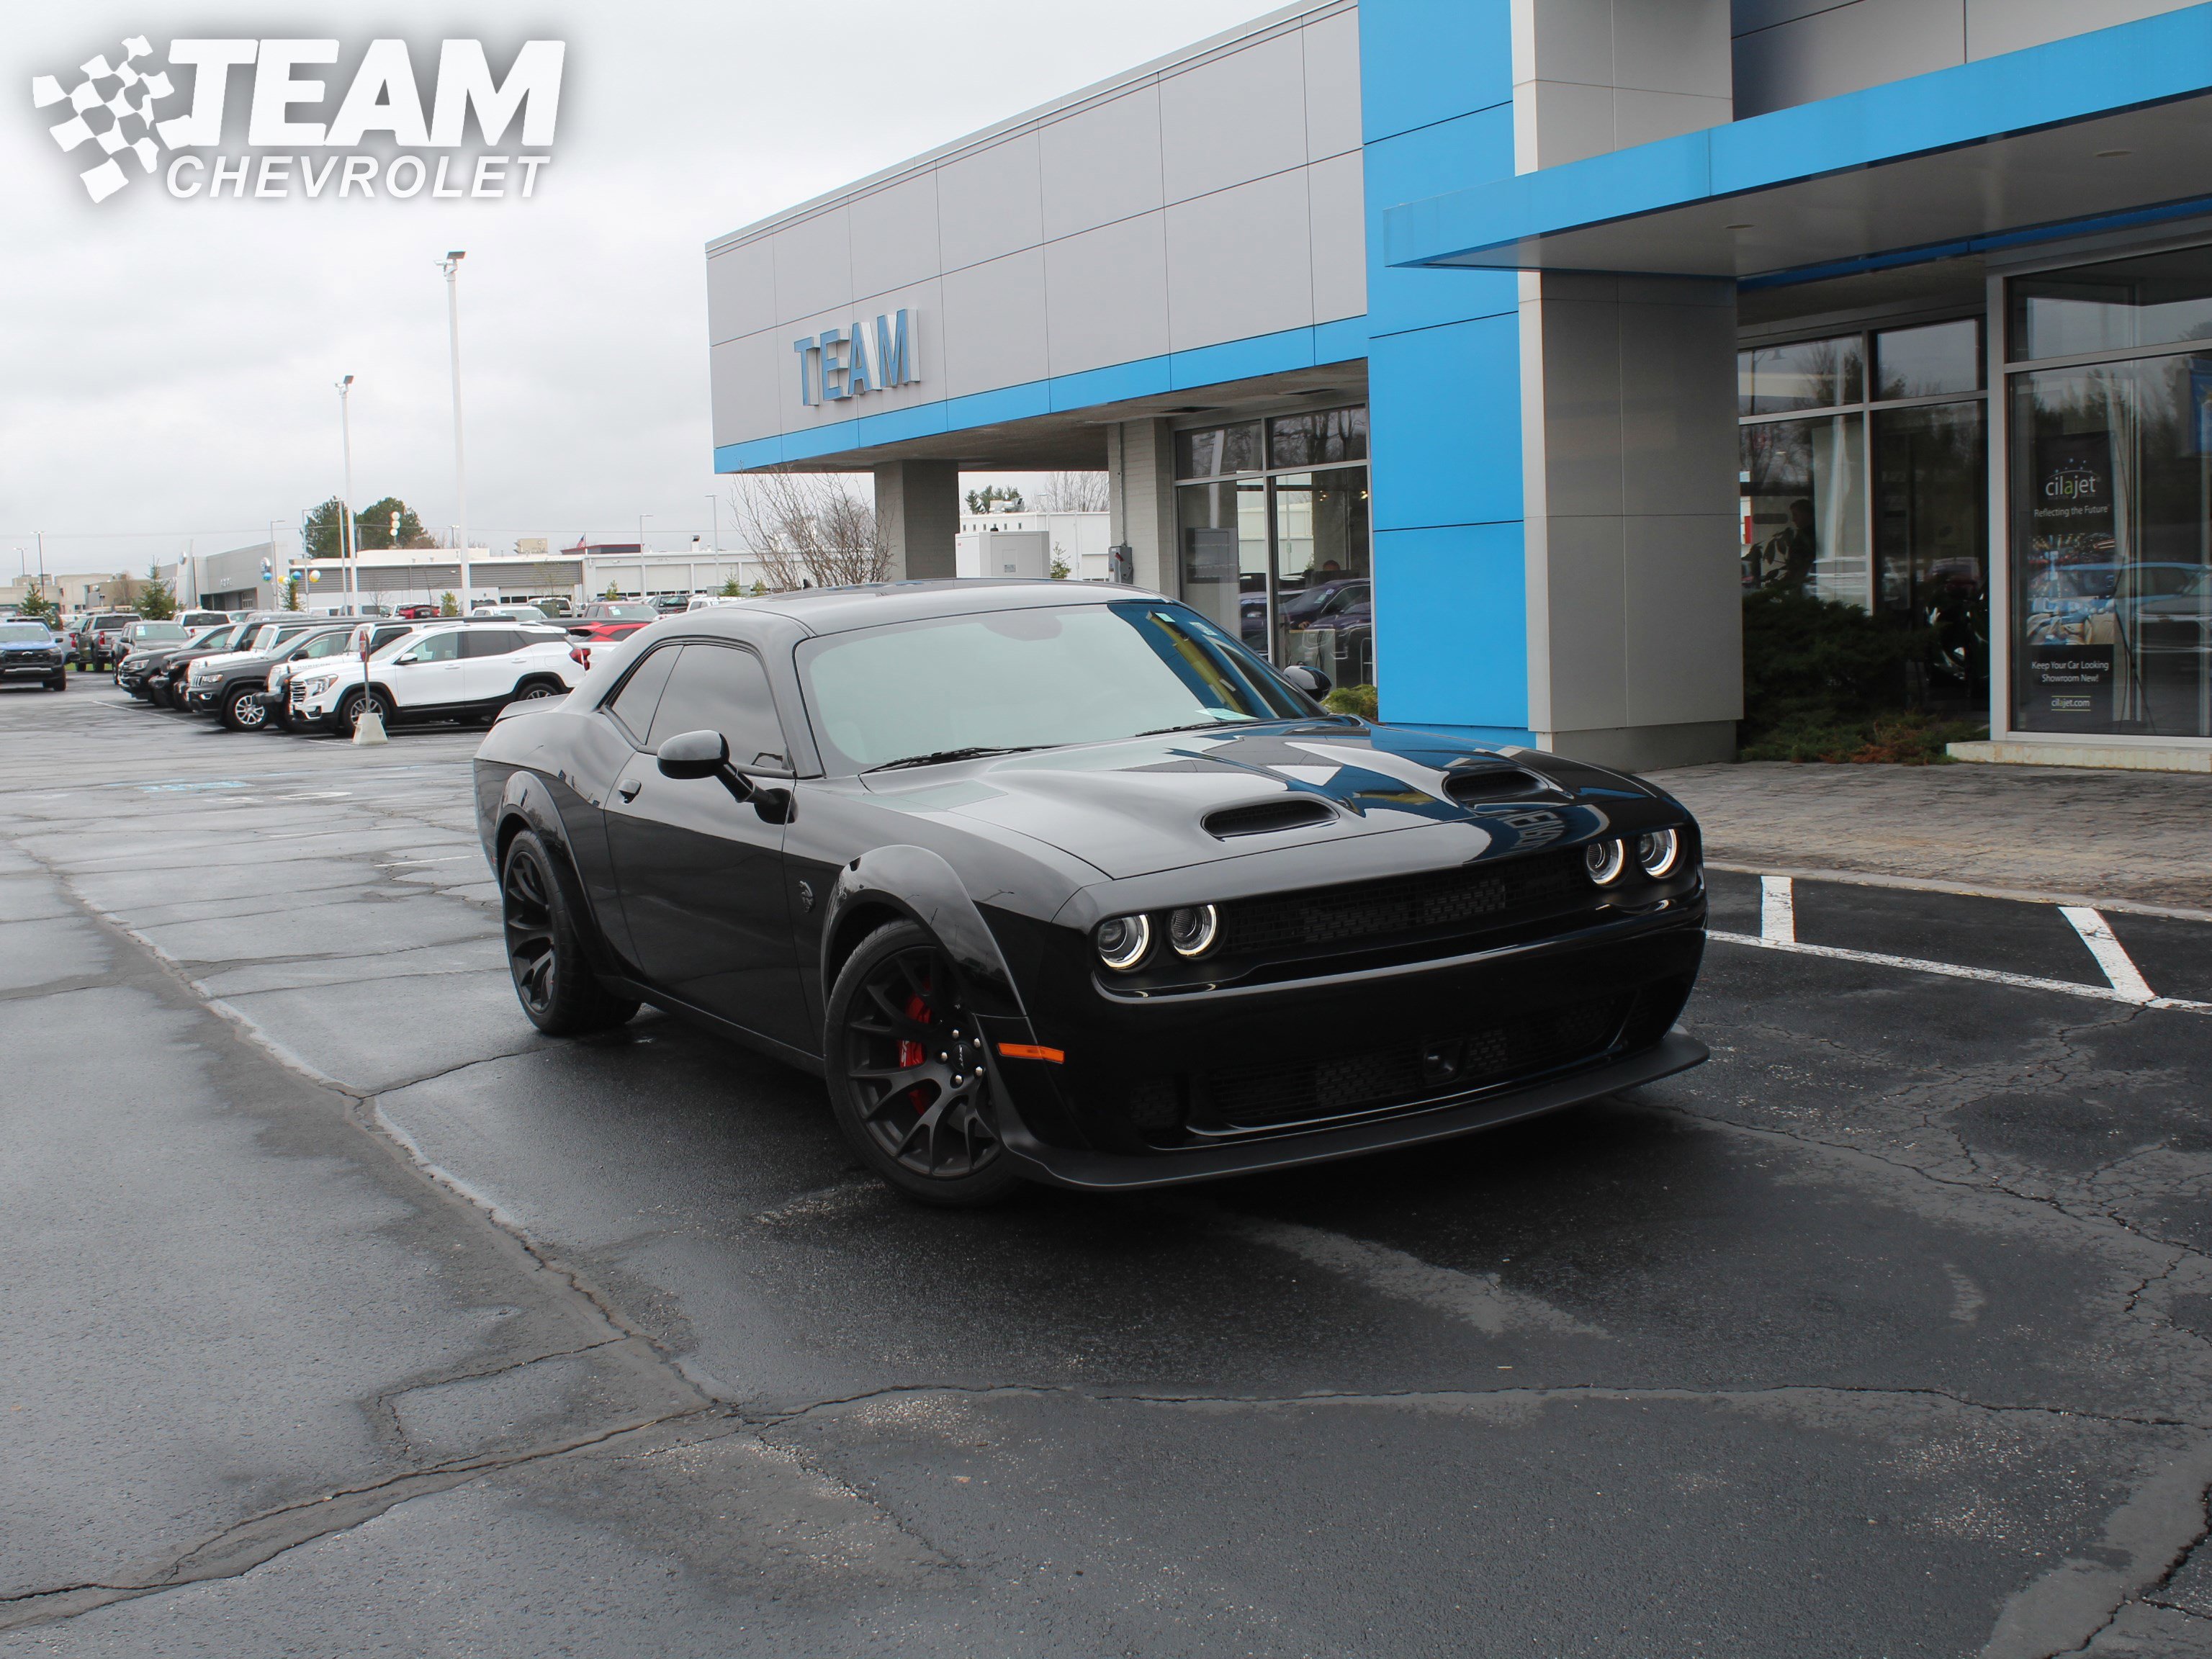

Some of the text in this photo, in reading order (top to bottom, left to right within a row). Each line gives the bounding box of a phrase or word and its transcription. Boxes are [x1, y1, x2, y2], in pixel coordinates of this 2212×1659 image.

[793, 308, 919, 406] TEAM
[2045, 475, 2097, 500] cilajet
[2033, 505, 2109, 518] Reflecting the Future
[2031, 660, 2110, 671] Keep Your Car Looking
[2051, 698, 2091, 709] cilajet.com
